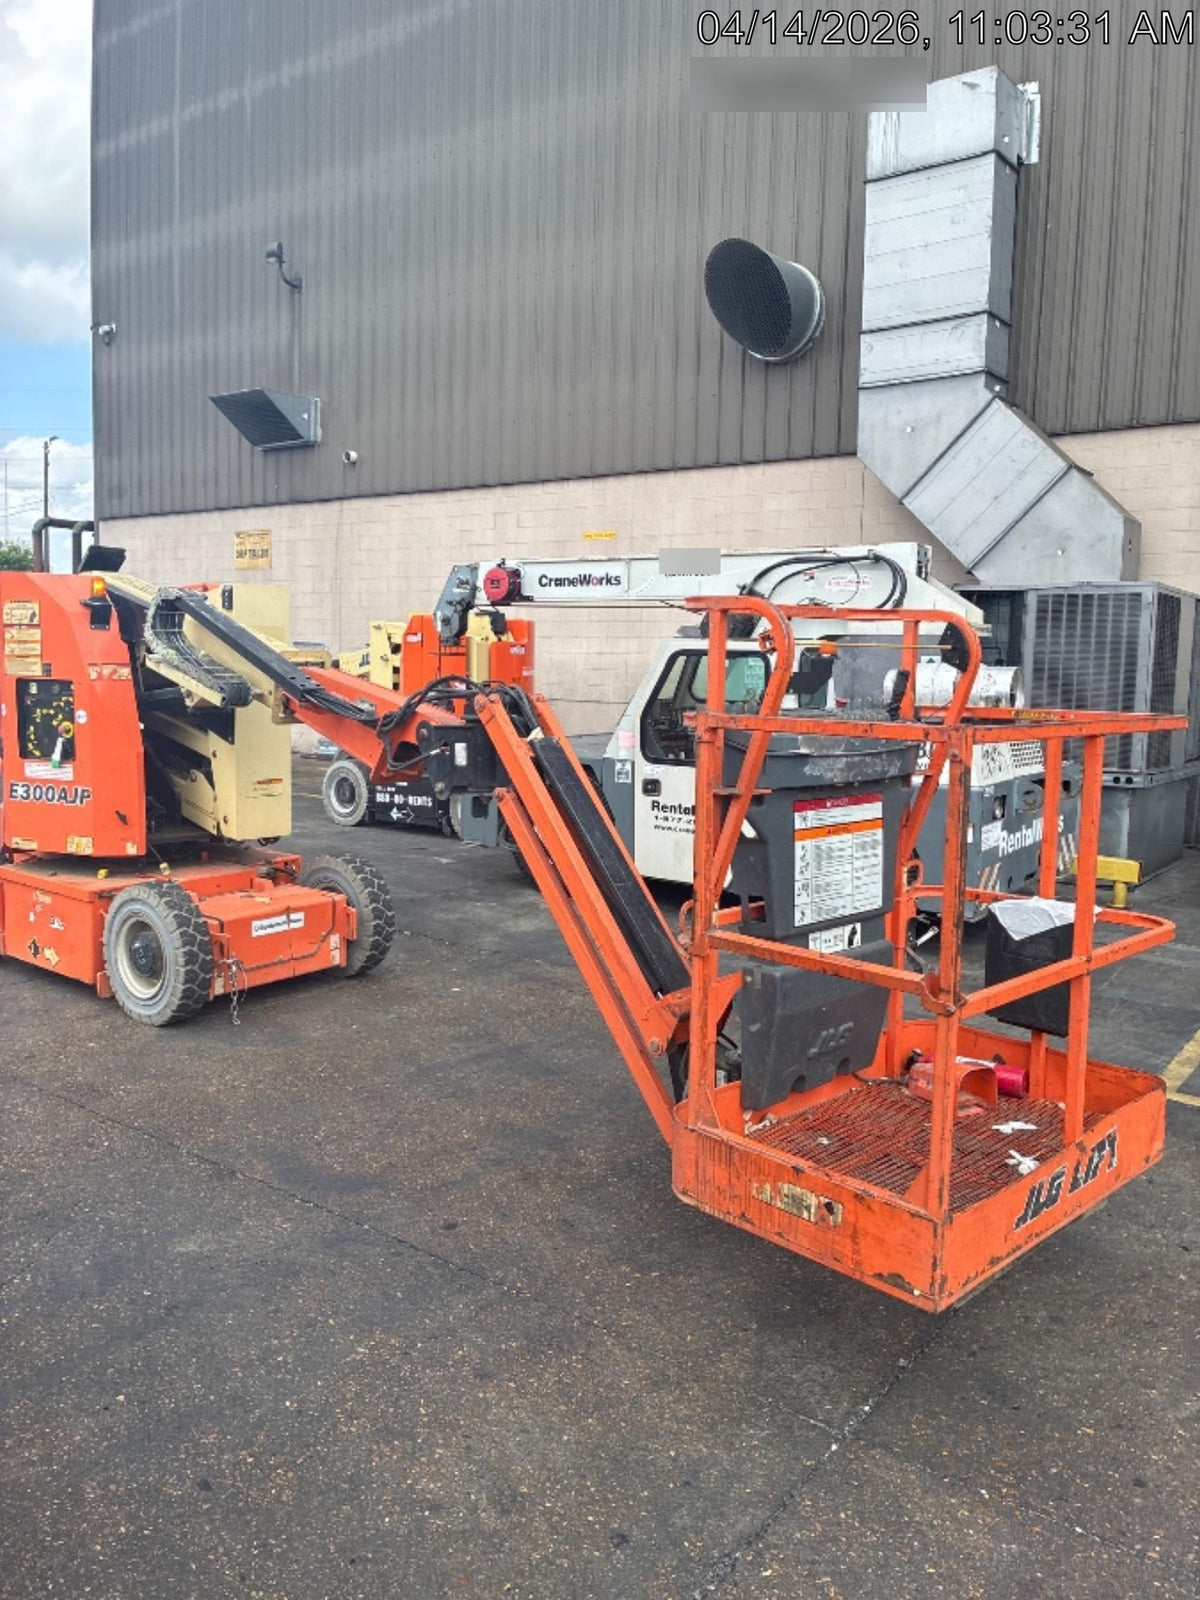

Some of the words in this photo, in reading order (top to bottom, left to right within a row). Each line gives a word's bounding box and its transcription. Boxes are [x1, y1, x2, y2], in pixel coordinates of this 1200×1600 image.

[538, 573, 622, 588] CraneWorks
[651, 799, 696, 816] Rental
[1014, 1164, 1067, 1232] JLG
